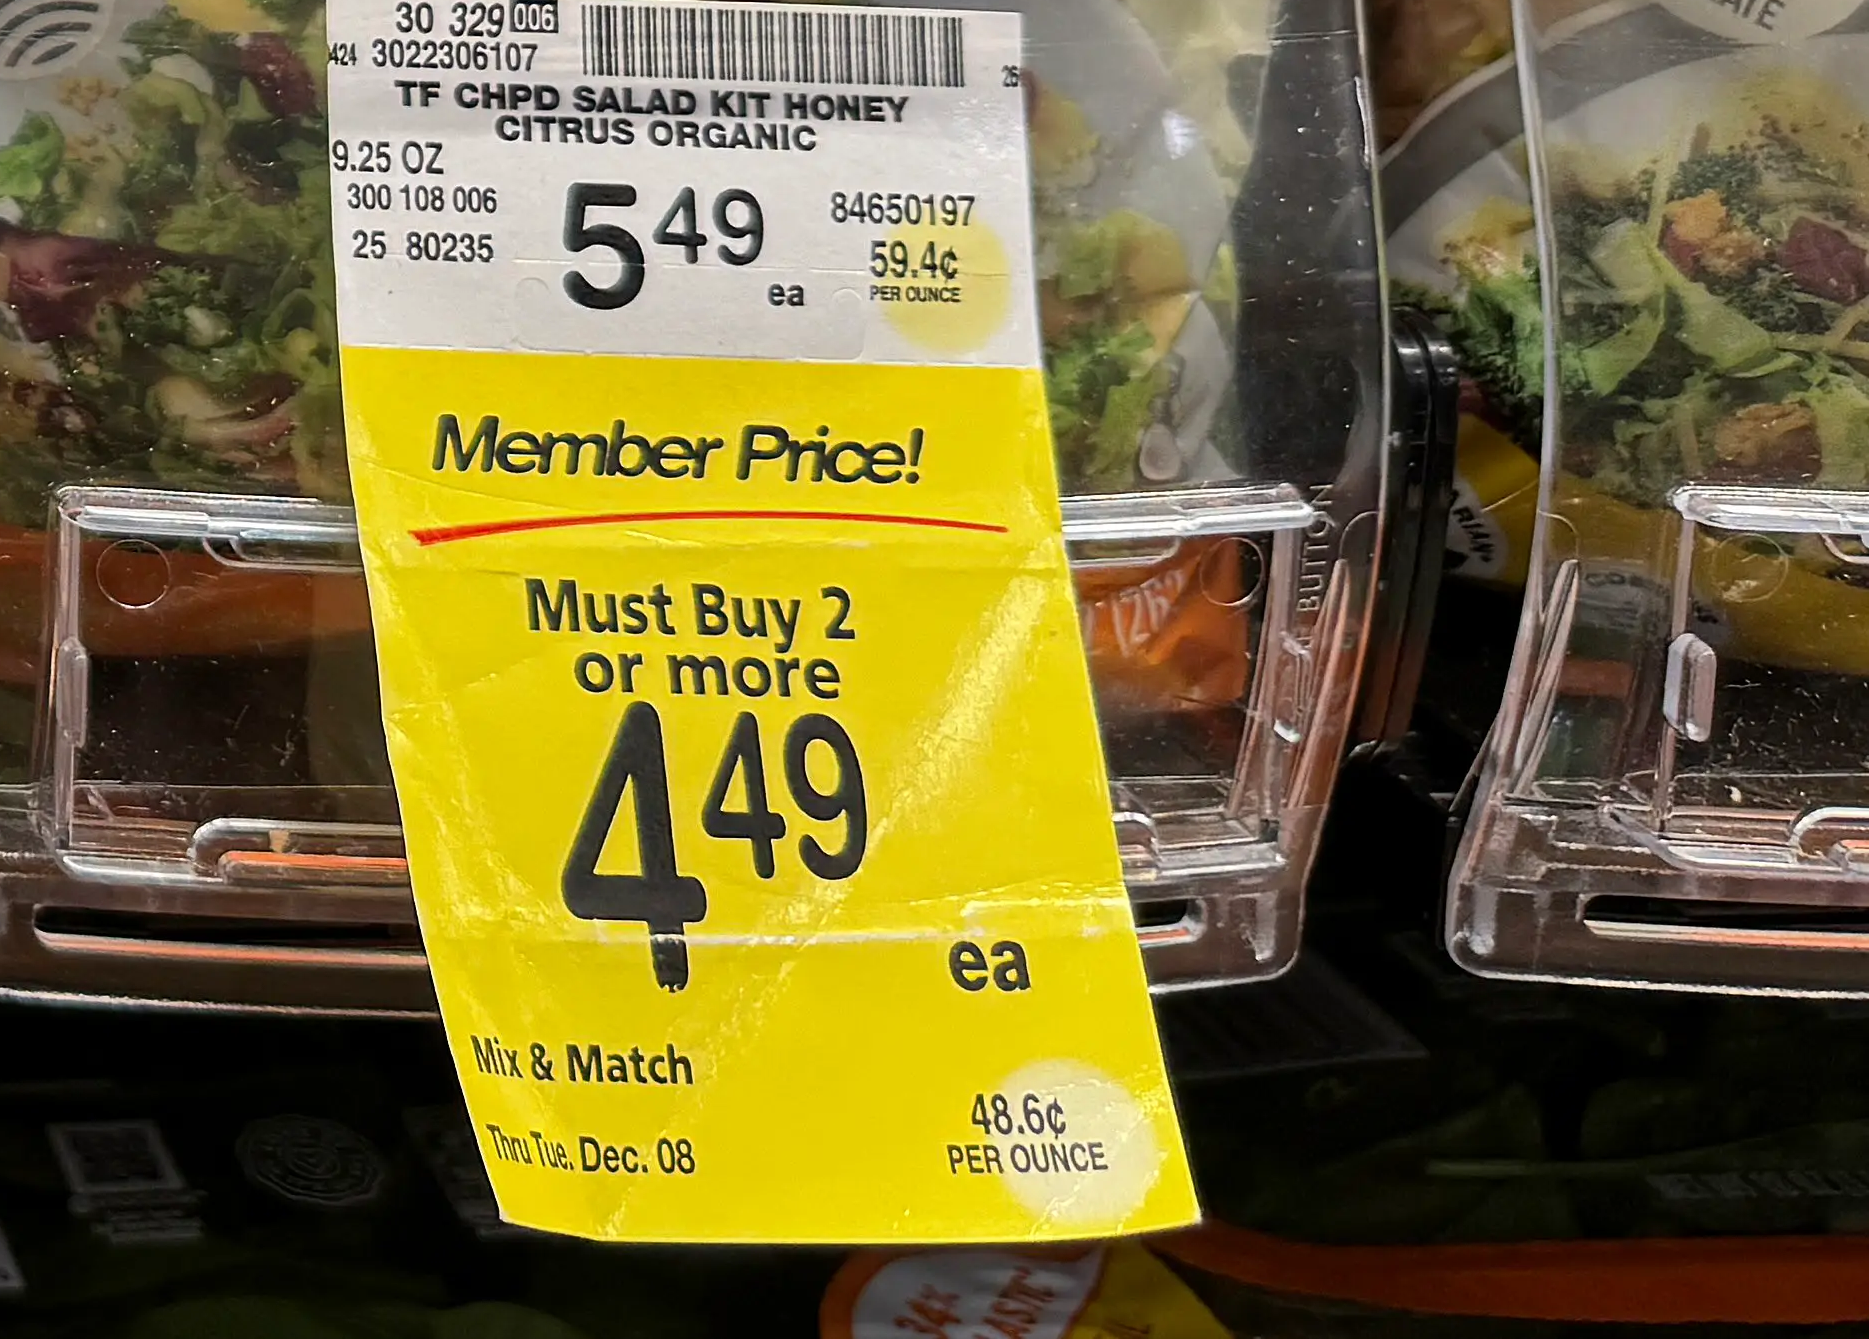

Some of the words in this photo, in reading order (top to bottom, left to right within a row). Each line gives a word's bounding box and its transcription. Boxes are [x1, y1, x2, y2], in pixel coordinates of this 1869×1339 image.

[395, 80, 440, 108] TF
[454, 83, 560, 112] CHPD
[572, 88, 698, 116] SALAD
[710, 91, 771, 118] KIT
[783, 94, 908, 123] HONEY
[495, 117, 635, 145] CITRUS
[647, 121, 817, 151] ORGANIC
[332, 142, 391, 173] 9.25
[402, 144, 444, 175] OZ
[831, 192, 975, 225] 84650197
[869, 241, 958, 280] 59.4¢
[971, 1094, 1066, 1138] 48.6¢
